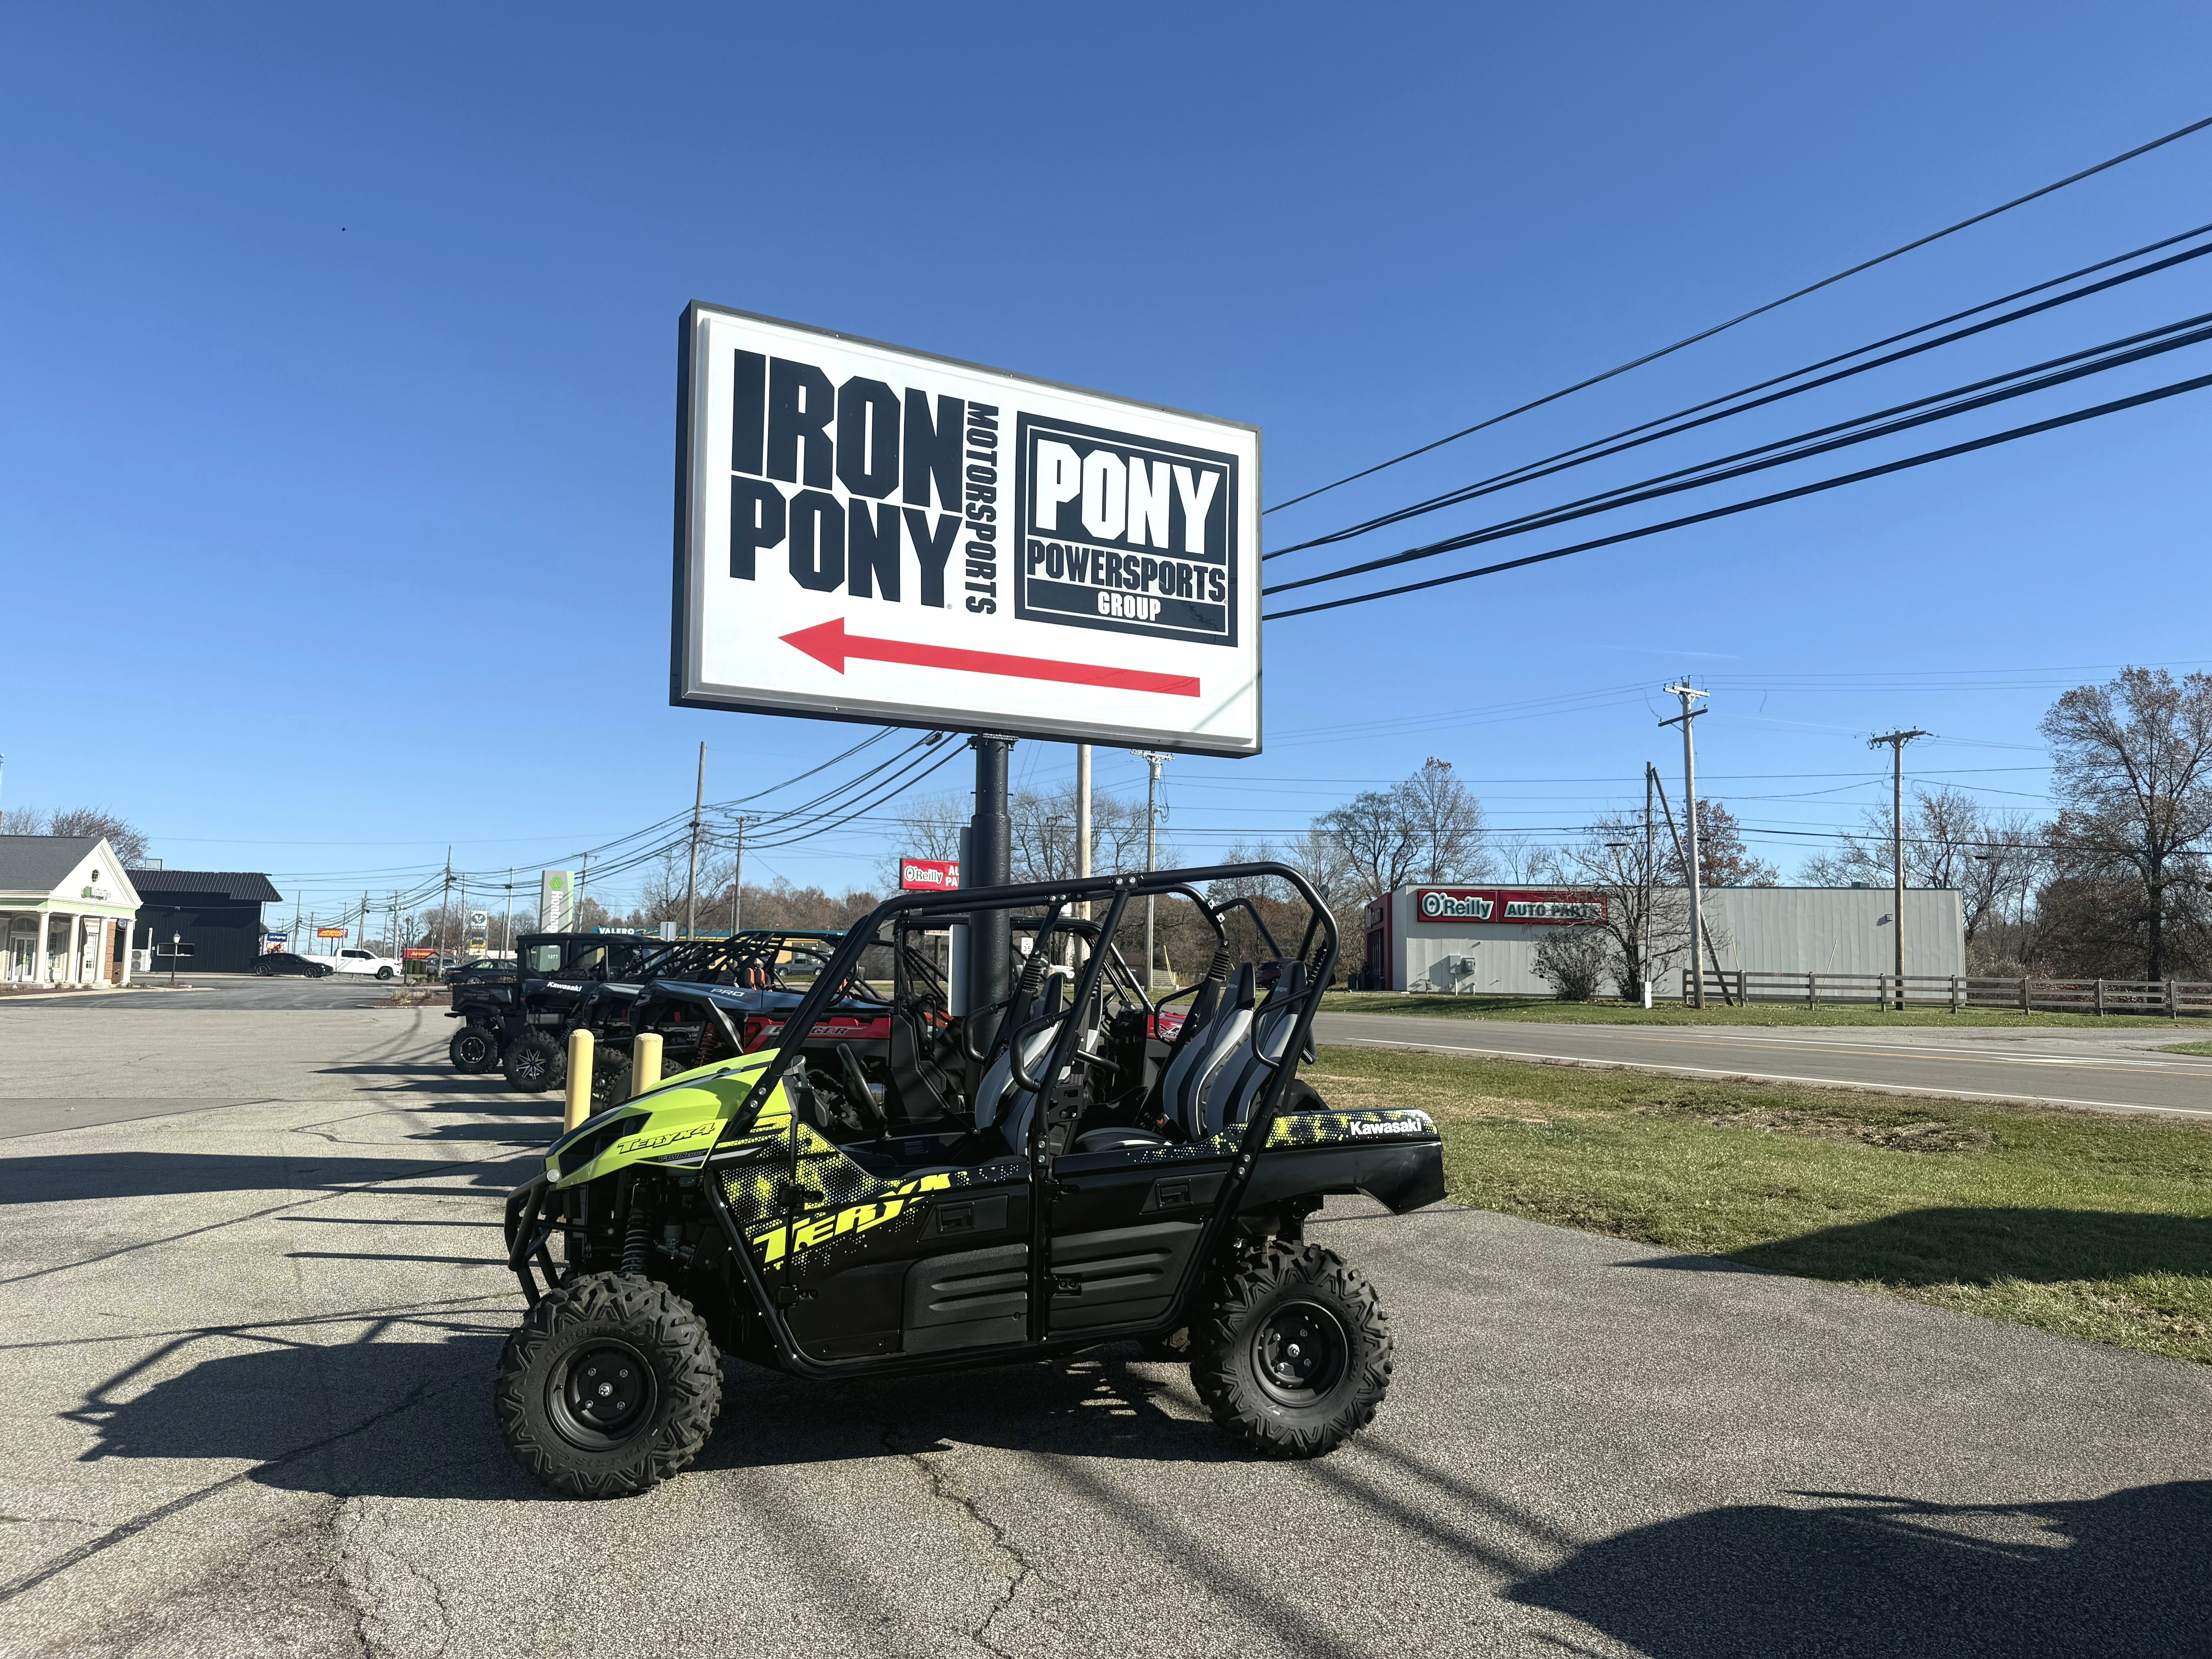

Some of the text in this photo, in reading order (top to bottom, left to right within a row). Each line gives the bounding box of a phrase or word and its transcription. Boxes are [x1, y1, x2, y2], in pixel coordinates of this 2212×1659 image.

[732, 349, 965, 513] IRON
[965, 401, 999, 615] MOTORSPORTS
[1036, 439, 1220, 555] PONY
[730, 475, 963, 608] PONY
[1027, 539, 1226, 602] POWERSPORTS
[1098, 591, 1161, 621] GROUP
[905, 866, 943, 883] O'Reilly
[546, 891, 563, 933] Hunting
[1423, 893, 1492, 918] O'Reilly
[1507, 903, 1546, 916] AUTO
[547, 981, 582, 992] Kawasaki
[710, 988, 745, 997] PRO
[1350, 1118, 1422, 1135] Kawasaki
[753, 1173, 951, 1264] TERYX
